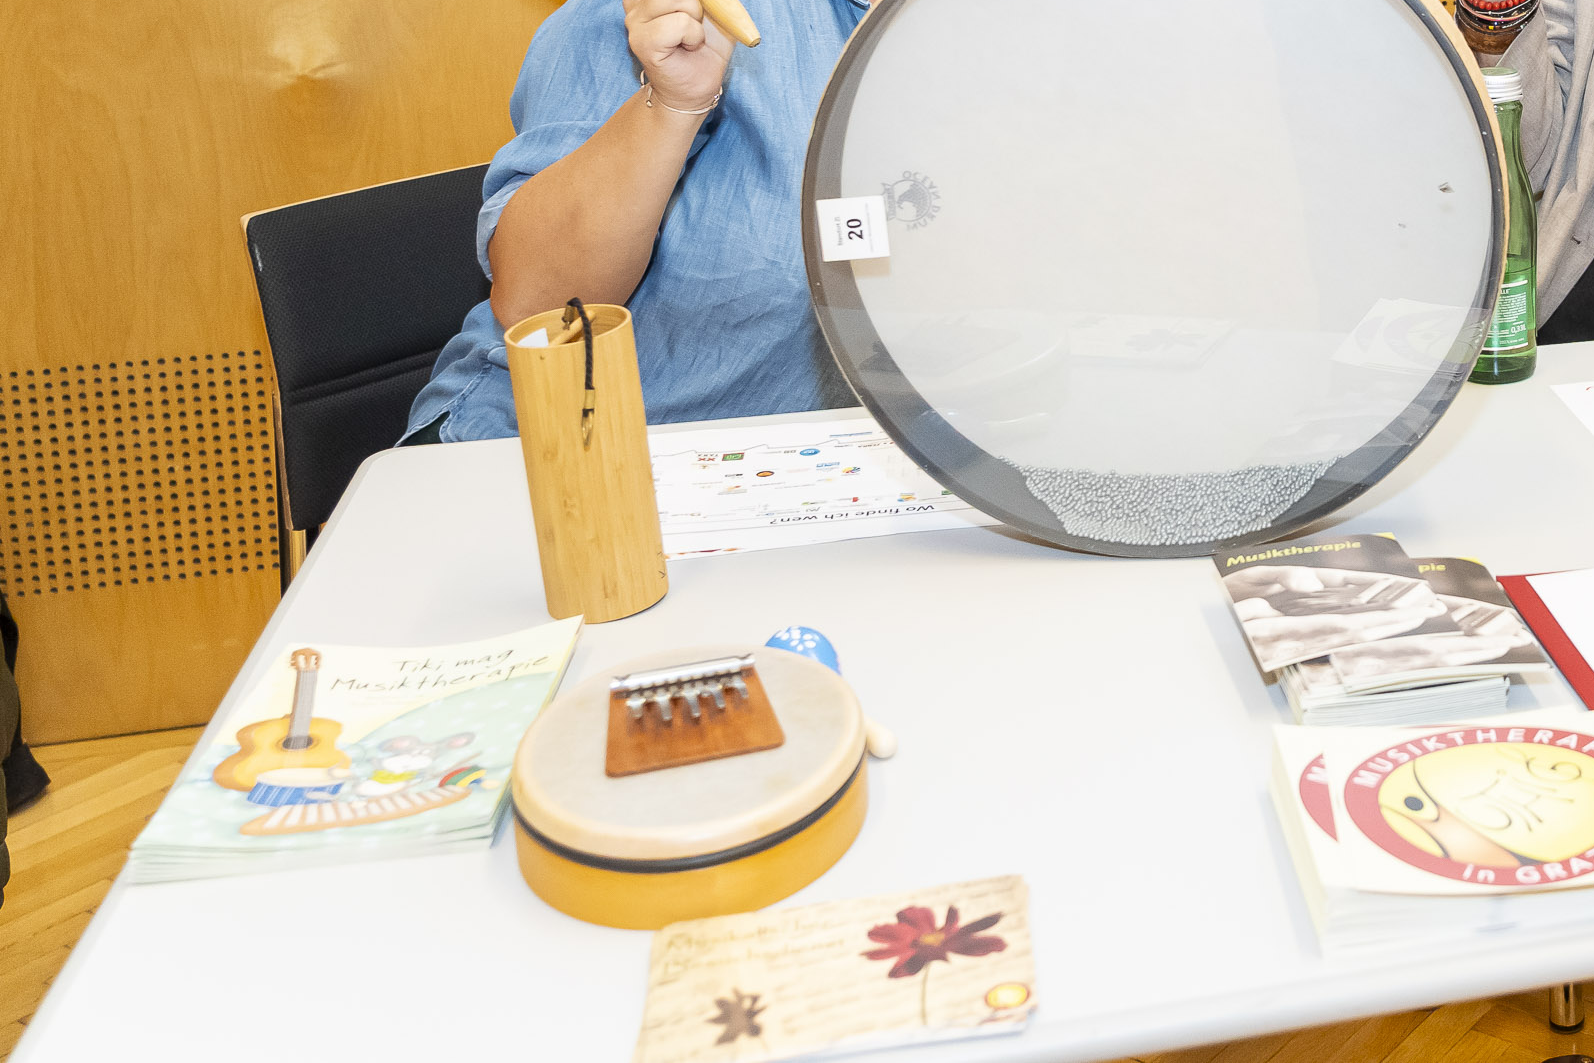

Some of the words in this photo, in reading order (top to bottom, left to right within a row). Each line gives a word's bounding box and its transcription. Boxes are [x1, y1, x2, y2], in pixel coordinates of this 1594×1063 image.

[846, 218, 864, 240] 20
[825, 512, 849, 520] ich
[855, 508, 901, 517] finde
[905, 504, 935, 512] Wo
[769, 515, 818, 525] wen?
[1226, 540, 1362, 567] Musiktherapie
[393, 657, 446, 673] Tiki
[455, 649, 514, 668] mag
[330, 654, 550, 691] Musiktherapie
